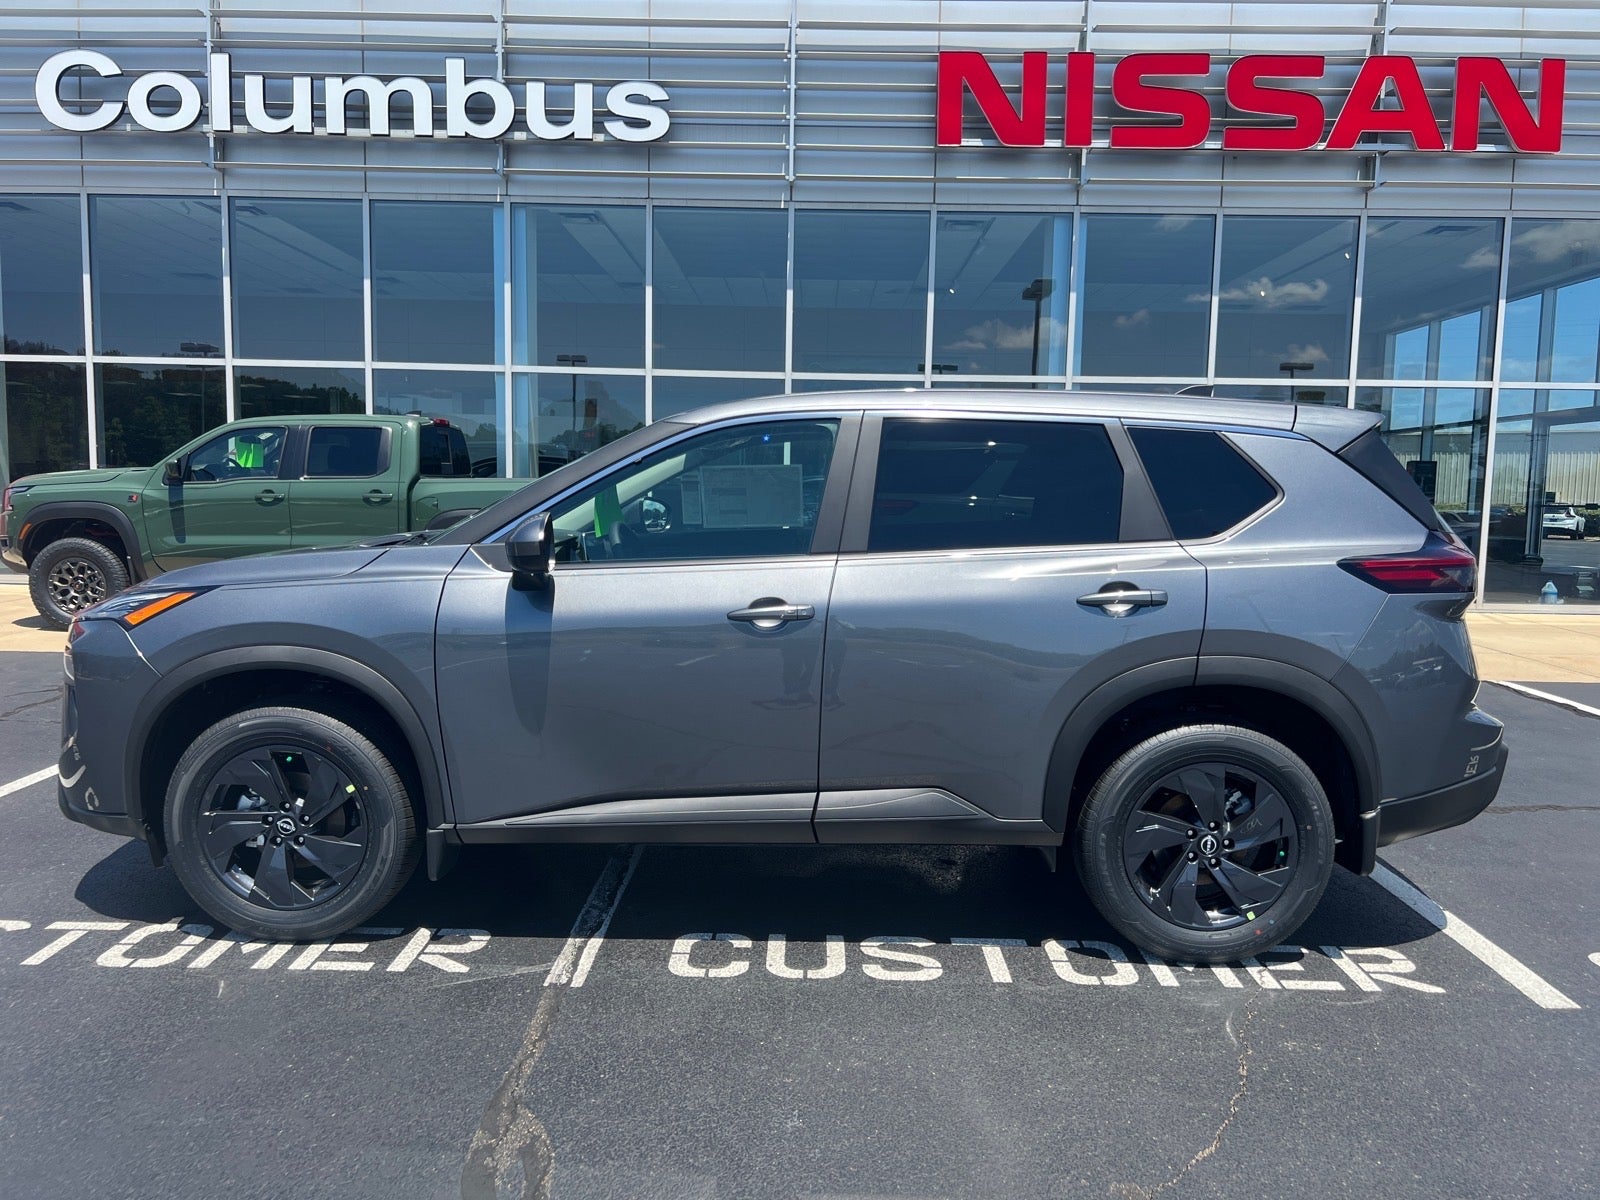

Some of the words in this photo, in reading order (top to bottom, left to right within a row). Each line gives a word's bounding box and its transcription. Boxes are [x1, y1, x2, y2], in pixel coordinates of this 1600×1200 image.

[35, 49, 671, 143] Columbus
[936, 51, 1566, 154] NISSAN
[0, 917, 491, 973] TOMER
